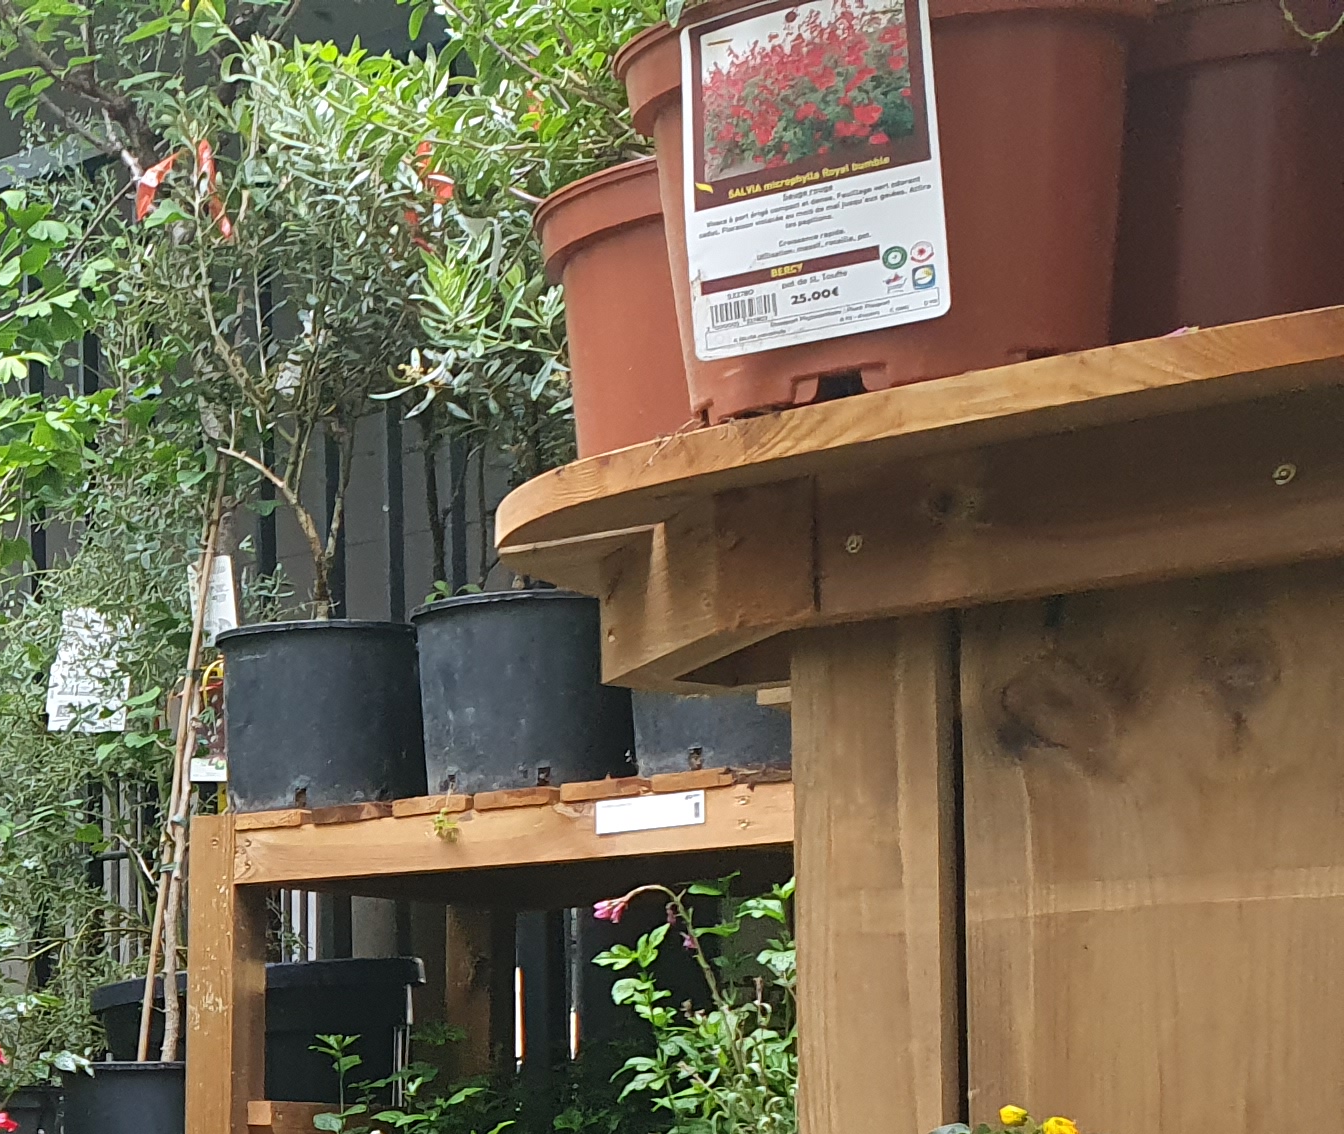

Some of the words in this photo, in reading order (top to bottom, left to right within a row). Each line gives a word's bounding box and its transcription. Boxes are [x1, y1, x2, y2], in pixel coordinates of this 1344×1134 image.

[728, 184, 762, 199] SALVIA
[822, 164, 850, 177] Royal
[770, 262, 804, 278] BERCY
[797, 278, 807, 286] de
[790, 286, 839, 305] 25.00€
